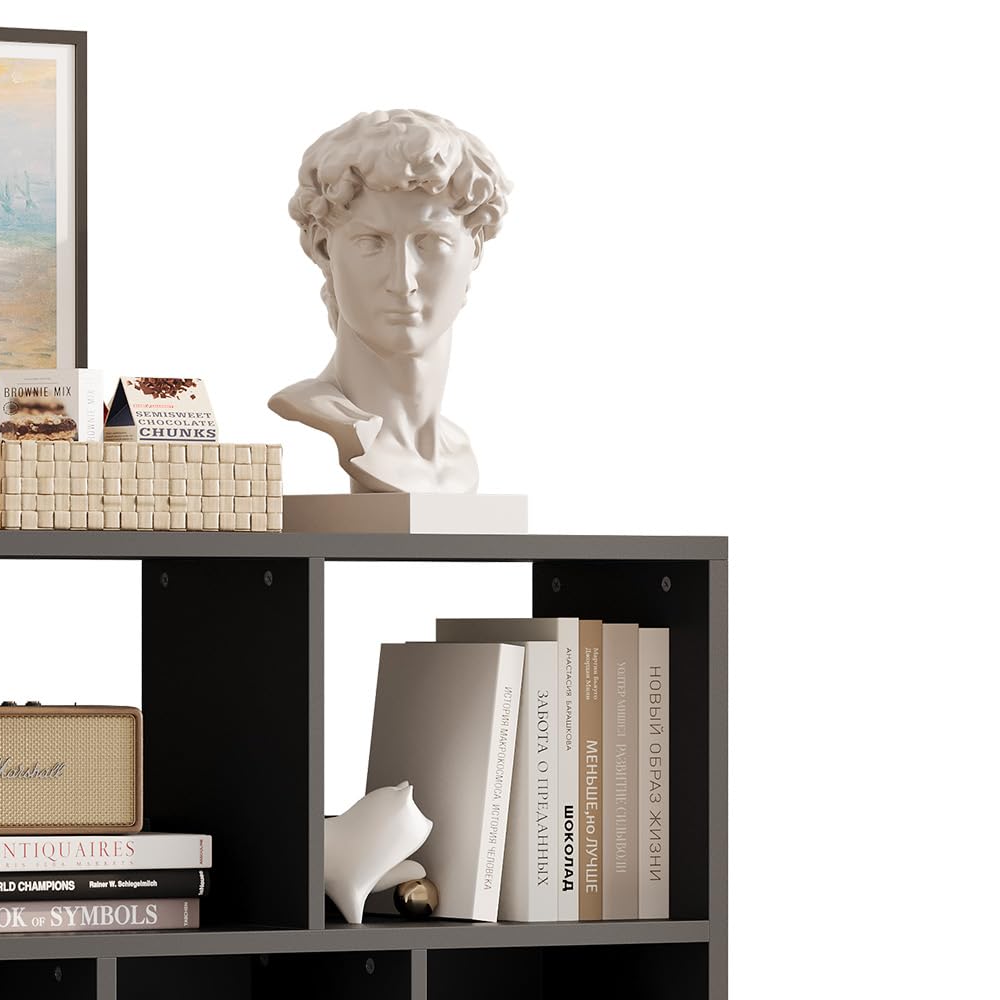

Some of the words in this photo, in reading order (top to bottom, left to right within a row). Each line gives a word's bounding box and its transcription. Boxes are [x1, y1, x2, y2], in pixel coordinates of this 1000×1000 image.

[4, 387, 49, 398] BROWNIE
[54, 386, 72, 397] MIX
[135, 411, 212, 419] SEMISWEET
[138, 419, 216, 427] CHOCOLATE
[139, 427, 216, 438] CHUNKS
[501, 686, 513, 726] ИСТОРИЯ
[649, 665, 664, 736] НОВЫЙ
[537, 690, 549, 754] ЗАБОТА
[537, 760, 549, 773] О
[649, 743, 662, 803] ОБРАЗ
[488, 803, 501, 845] ИСТОРИЯ
[537, 779, 550, 887] ПРЕДАННЫХ
[562, 805, 574, 892] ШОКОЛАД
[585, 837, 598, 894] ЛУЧШЕ
[649, 810, 662, 882] ЖИЗНИ
[18, 880, 75, 892] CHAMPIONS
[89, 880, 107, 888] Rainer
[108, 880, 117, 888] W.
[483, 846, 497, 891] ЧЕЛОВЕКА
[32, 917, 45, 928] OF
[50, 904, 158, 927] SYMBOLS
